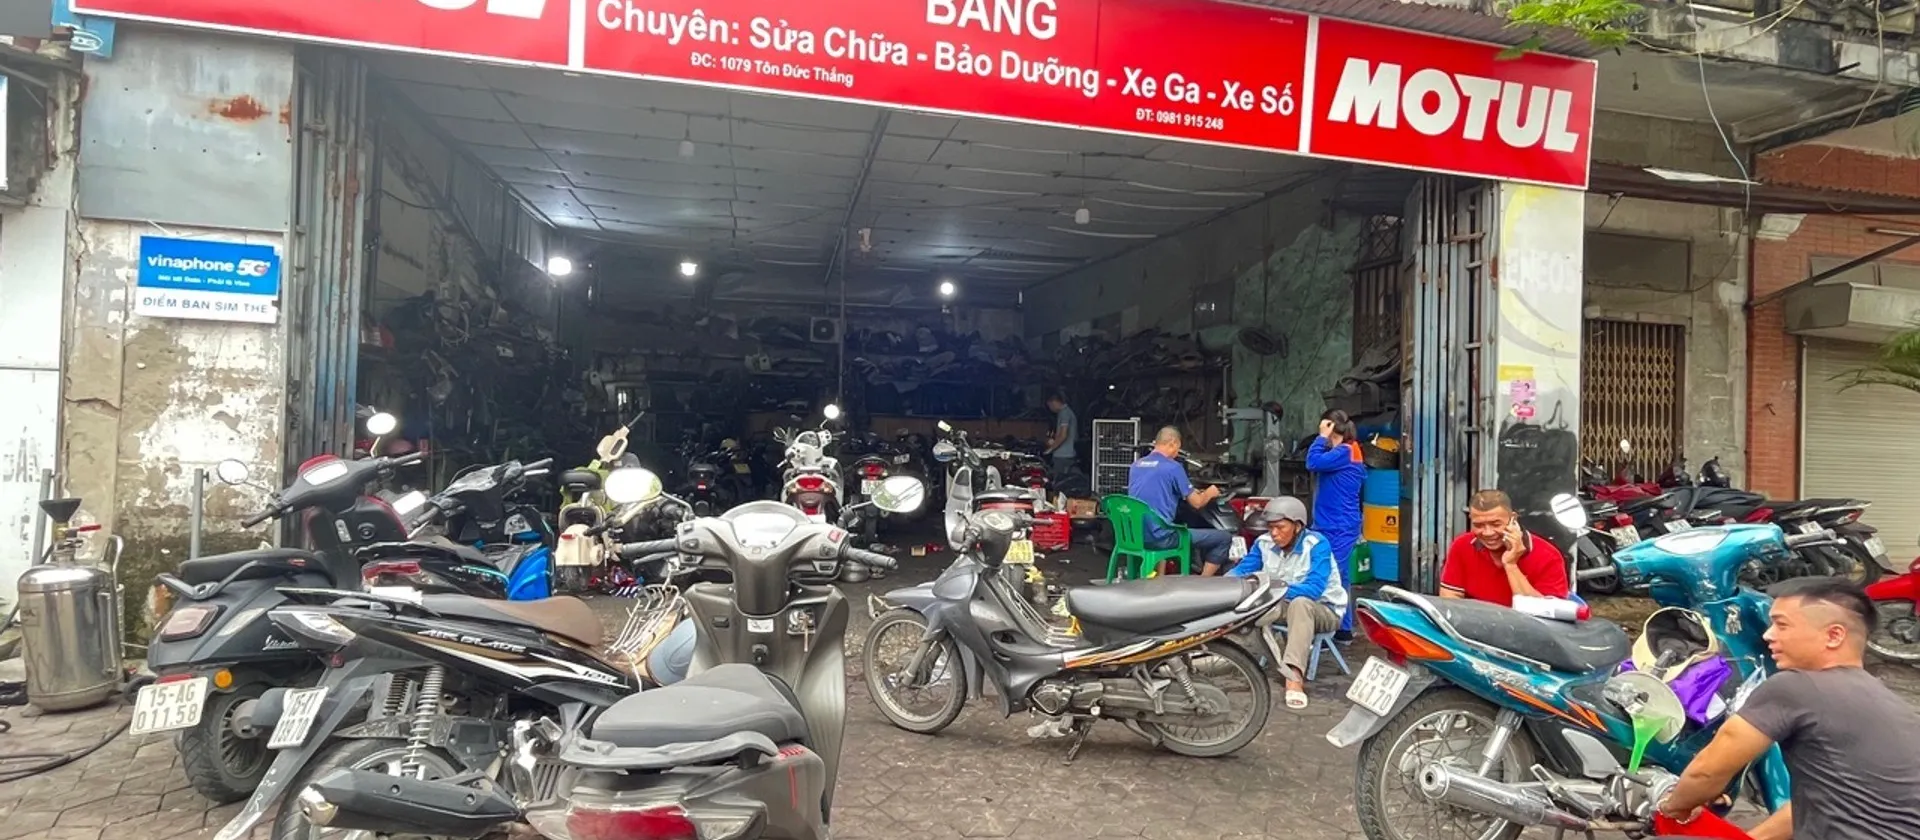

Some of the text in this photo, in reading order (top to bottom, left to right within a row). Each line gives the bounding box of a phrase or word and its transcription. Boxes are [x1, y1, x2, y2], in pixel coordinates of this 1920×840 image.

[597, 0, 739, 45] Chuyên:
[750, 17, 815, 55] Sửa
[824, 27, 908, 65] Chữa
[935, 41, 992, 77] Bảo
[1000, 50, 1099, 98] Dưỡng
[1121, 66, 1157, 98] Xe
[1164, 73, 1199, 104] Ga
[1220, 80, 1254, 111] Xe
[1260, 82, 1295, 116] Số
[691, 52, 717, 68] ĐC:
[720, 57, 751, 73] 1079
[754, 60, 779, 76] Tôn
[782, 63, 810, 80] Đức
[1327, 57, 1579, 153] MOTUL
[1136, 108, 1224, 131] ĐT: 0981 915 248
[147, 254, 234, 272] vinaphone
[215, 302, 238, 312] SIM
[1367, 663, 1401, 689] 15-B1
[150, 683, 195, 708] 15-AG
[137, 704, 198, 730] 011.58
